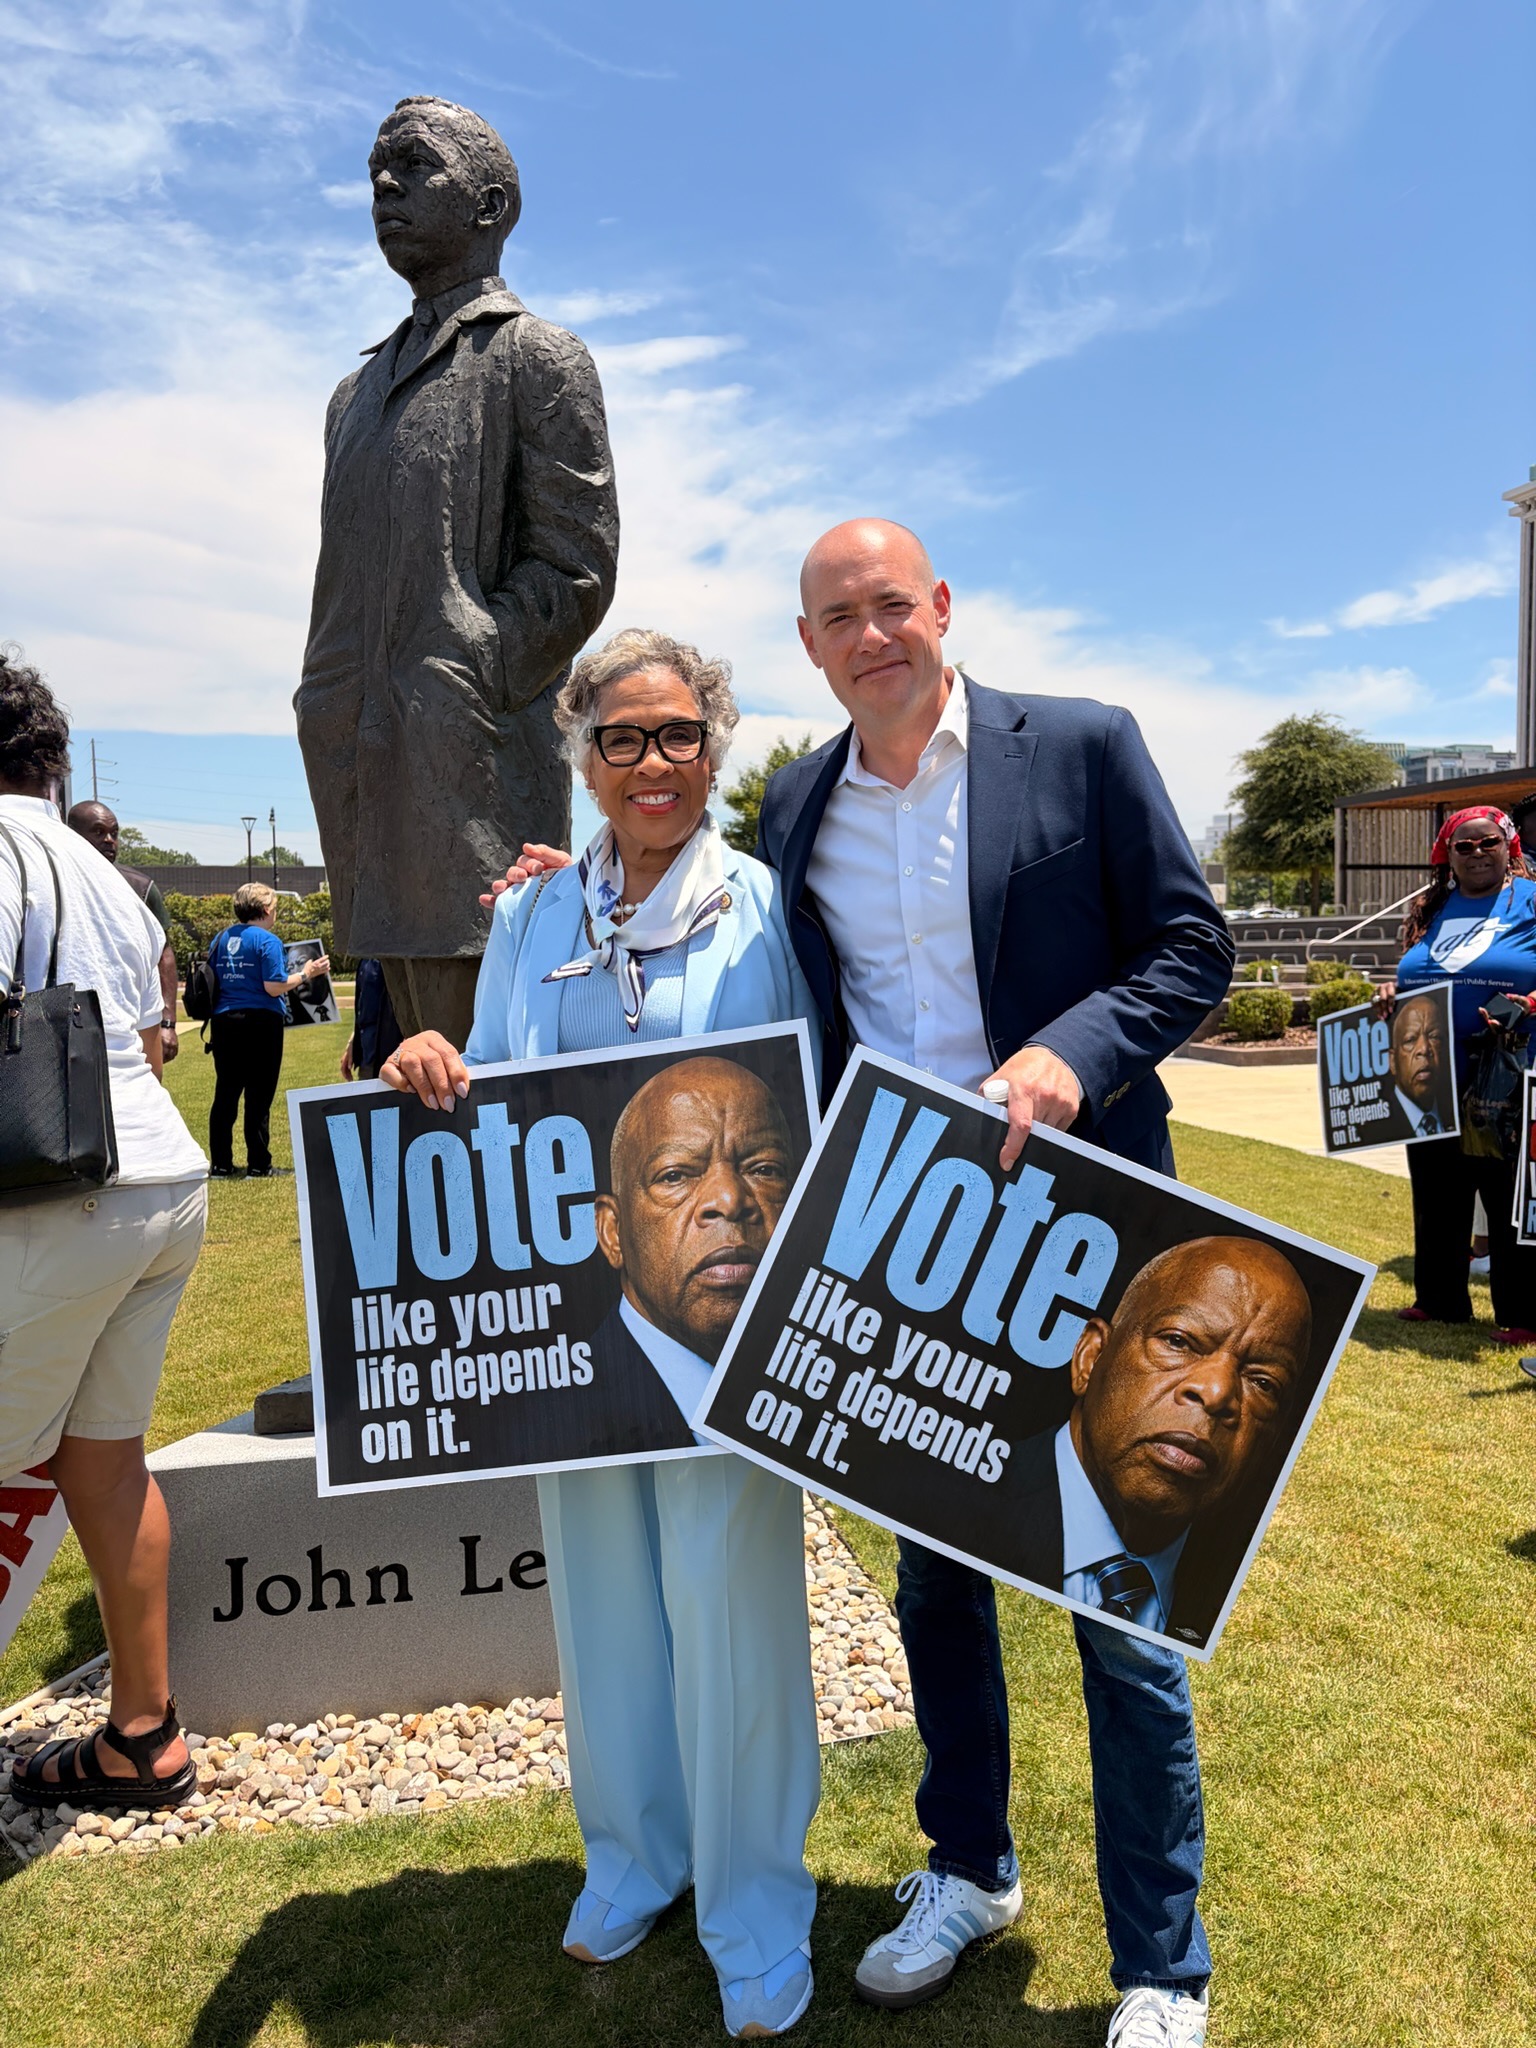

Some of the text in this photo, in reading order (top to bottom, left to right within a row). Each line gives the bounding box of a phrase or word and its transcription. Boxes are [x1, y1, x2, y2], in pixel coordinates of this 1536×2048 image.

[1467, 977, 1487, 986] Public
[1324, 1017, 1390, 1086] Vote
[1329, 1080, 1381, 1107] like your
[1330, 1098, 1390, 1128] life depends
[1333, 1125, 1361, 1146] on it.
[325, 1102, 598, 1289] Vote
[822, 1087, 1119, 1369] Vote
[351, 1282, 562, 1351] like your
[788, 1267, 1011, 1410] like your
[356, 1334, 594, 1411] life depends
[764, 1325, 1011, 1483] life depends
[361, 1407, 471, 1464] on it.
[745, 1389, 850, 1474] on it.
[212, 1545, 414, 1623] John
